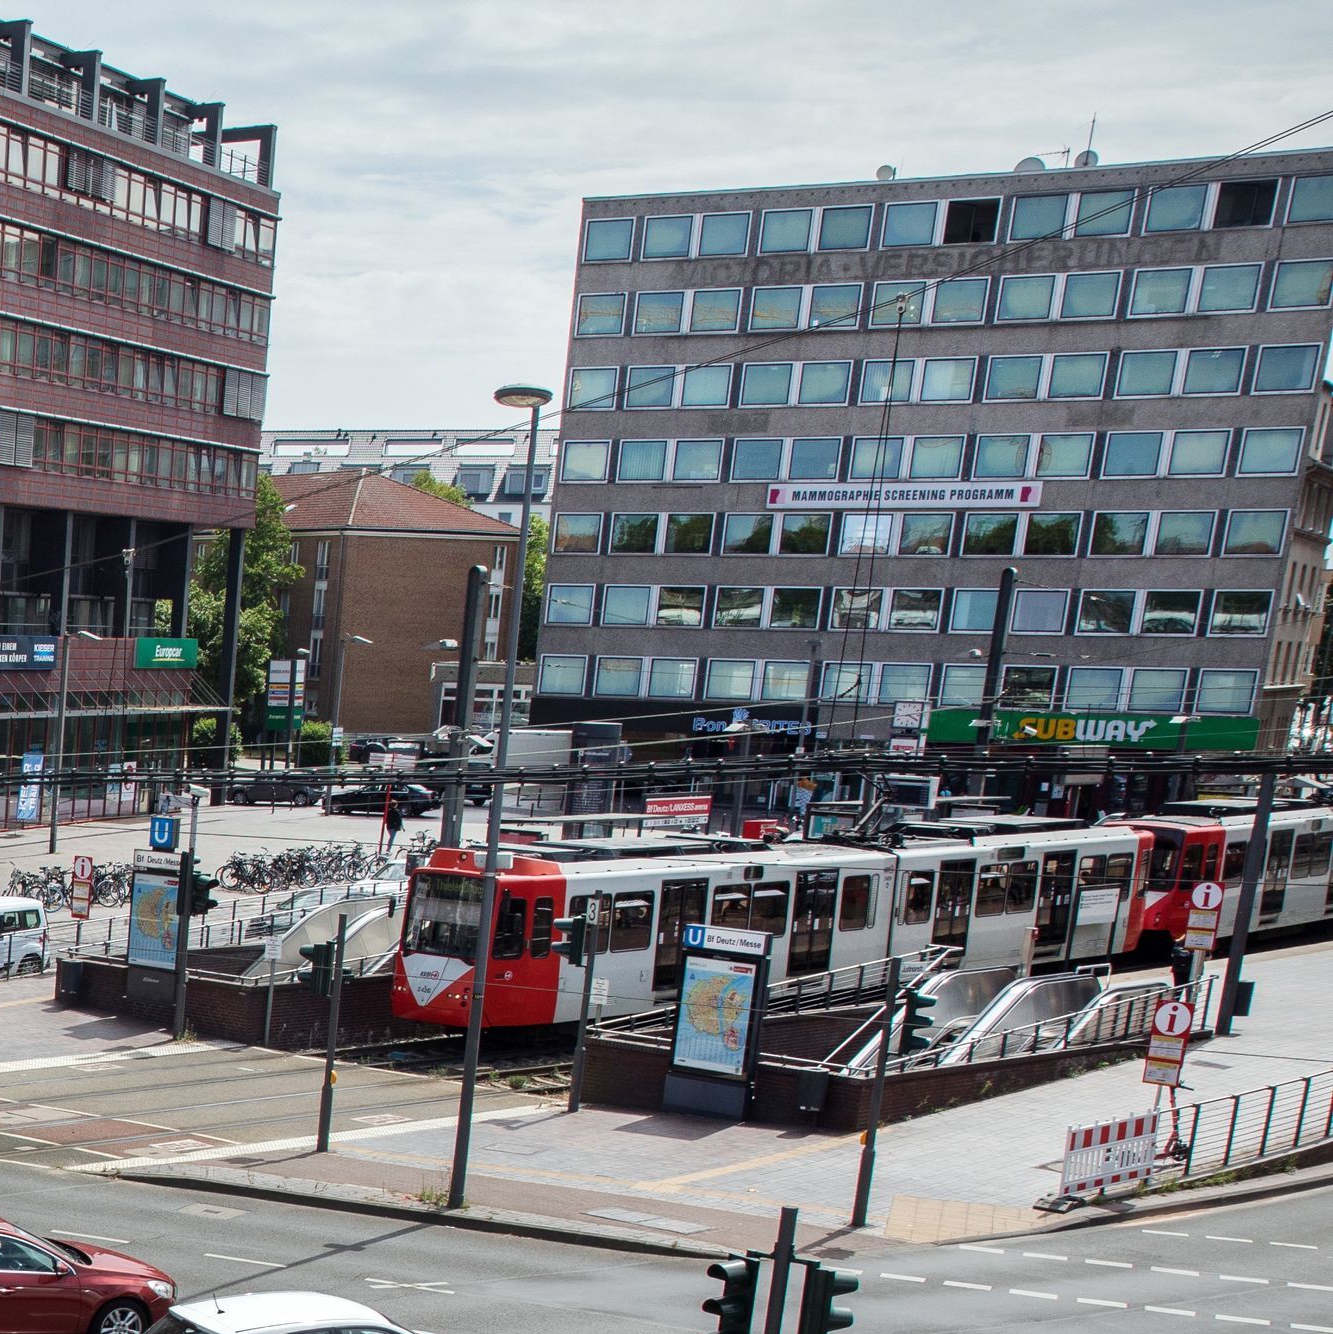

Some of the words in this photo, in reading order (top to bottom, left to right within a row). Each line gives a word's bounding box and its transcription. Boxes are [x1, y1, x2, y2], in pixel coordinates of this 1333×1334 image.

[791, 490, 880, 502] MAMMOGRAPHIE
[884, 489, 945, 501] SCREENING
[949, 488, 1015, 500] PROGRAMM
[9, 653, 27, 663] KÖRPER
[155, 644, 183, 660] Europcar
[693, 717, 727, 732] Bon
[1013, 717, 1157, 742] SUBWAY
[155, 821, 169, 844] U
[136, 854, 144, 863] Bf
[588, 903, 596, 920] 3
[688, 928, 702, 945] U
[707, 934, 715, 943] Bf
